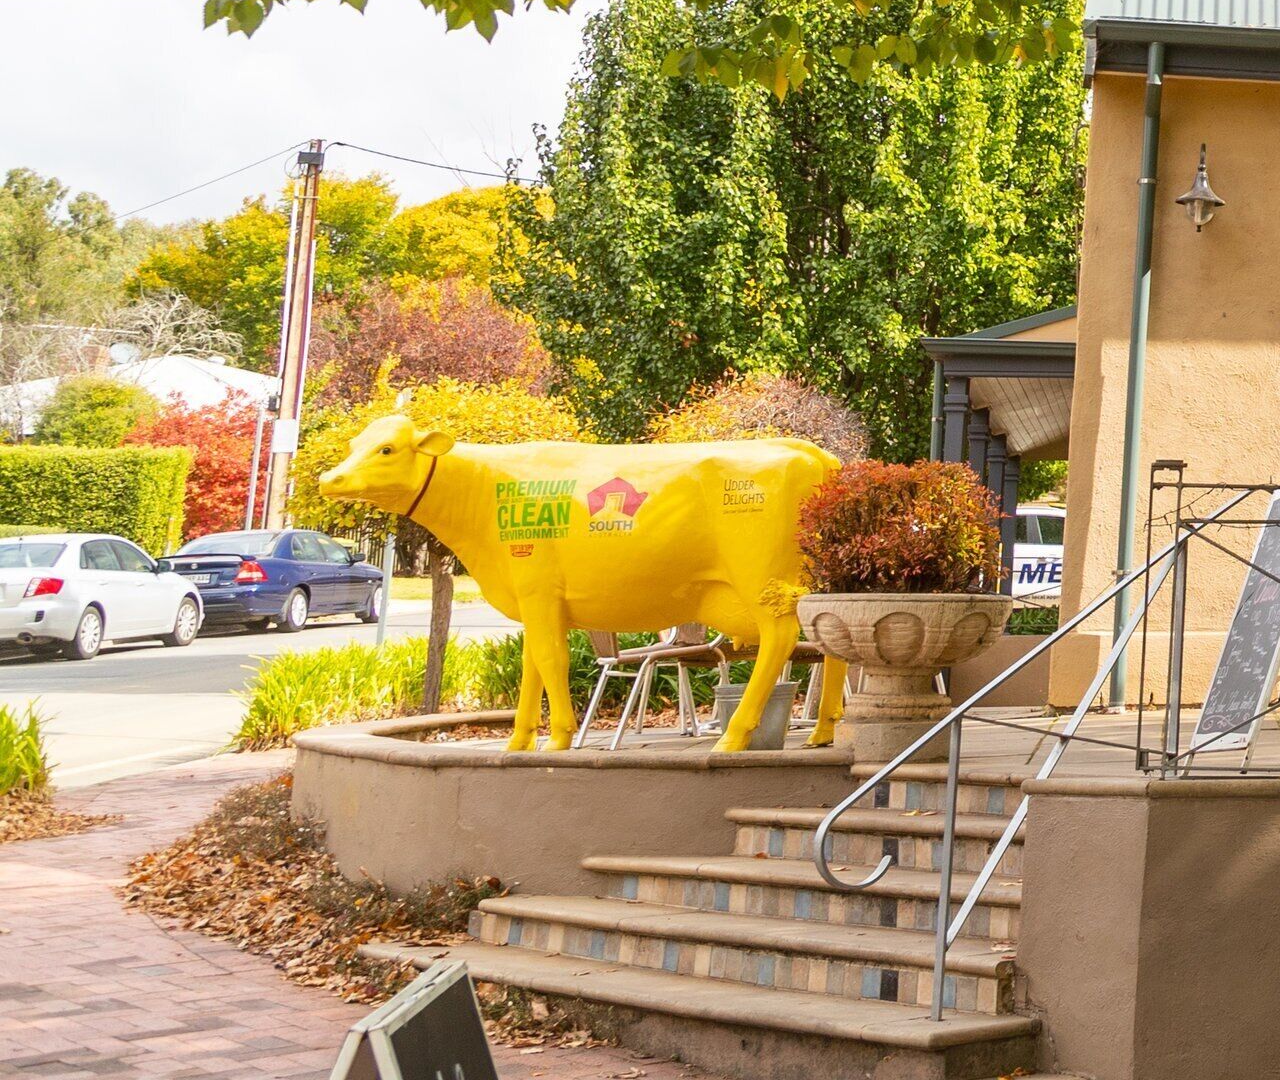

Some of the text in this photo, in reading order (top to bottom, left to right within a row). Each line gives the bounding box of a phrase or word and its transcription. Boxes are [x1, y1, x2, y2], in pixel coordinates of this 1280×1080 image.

[496, 480, 577, 499] PREMIUM
[724, 479, 755, 491] UDDER
[723, 493, 765, 505] DELIGHTS
[497, 502, 571, 530] CLEAN
[589, 520, 633, 532] SOUTH
[500, 527, 570, 542] ENVIRONMENT
